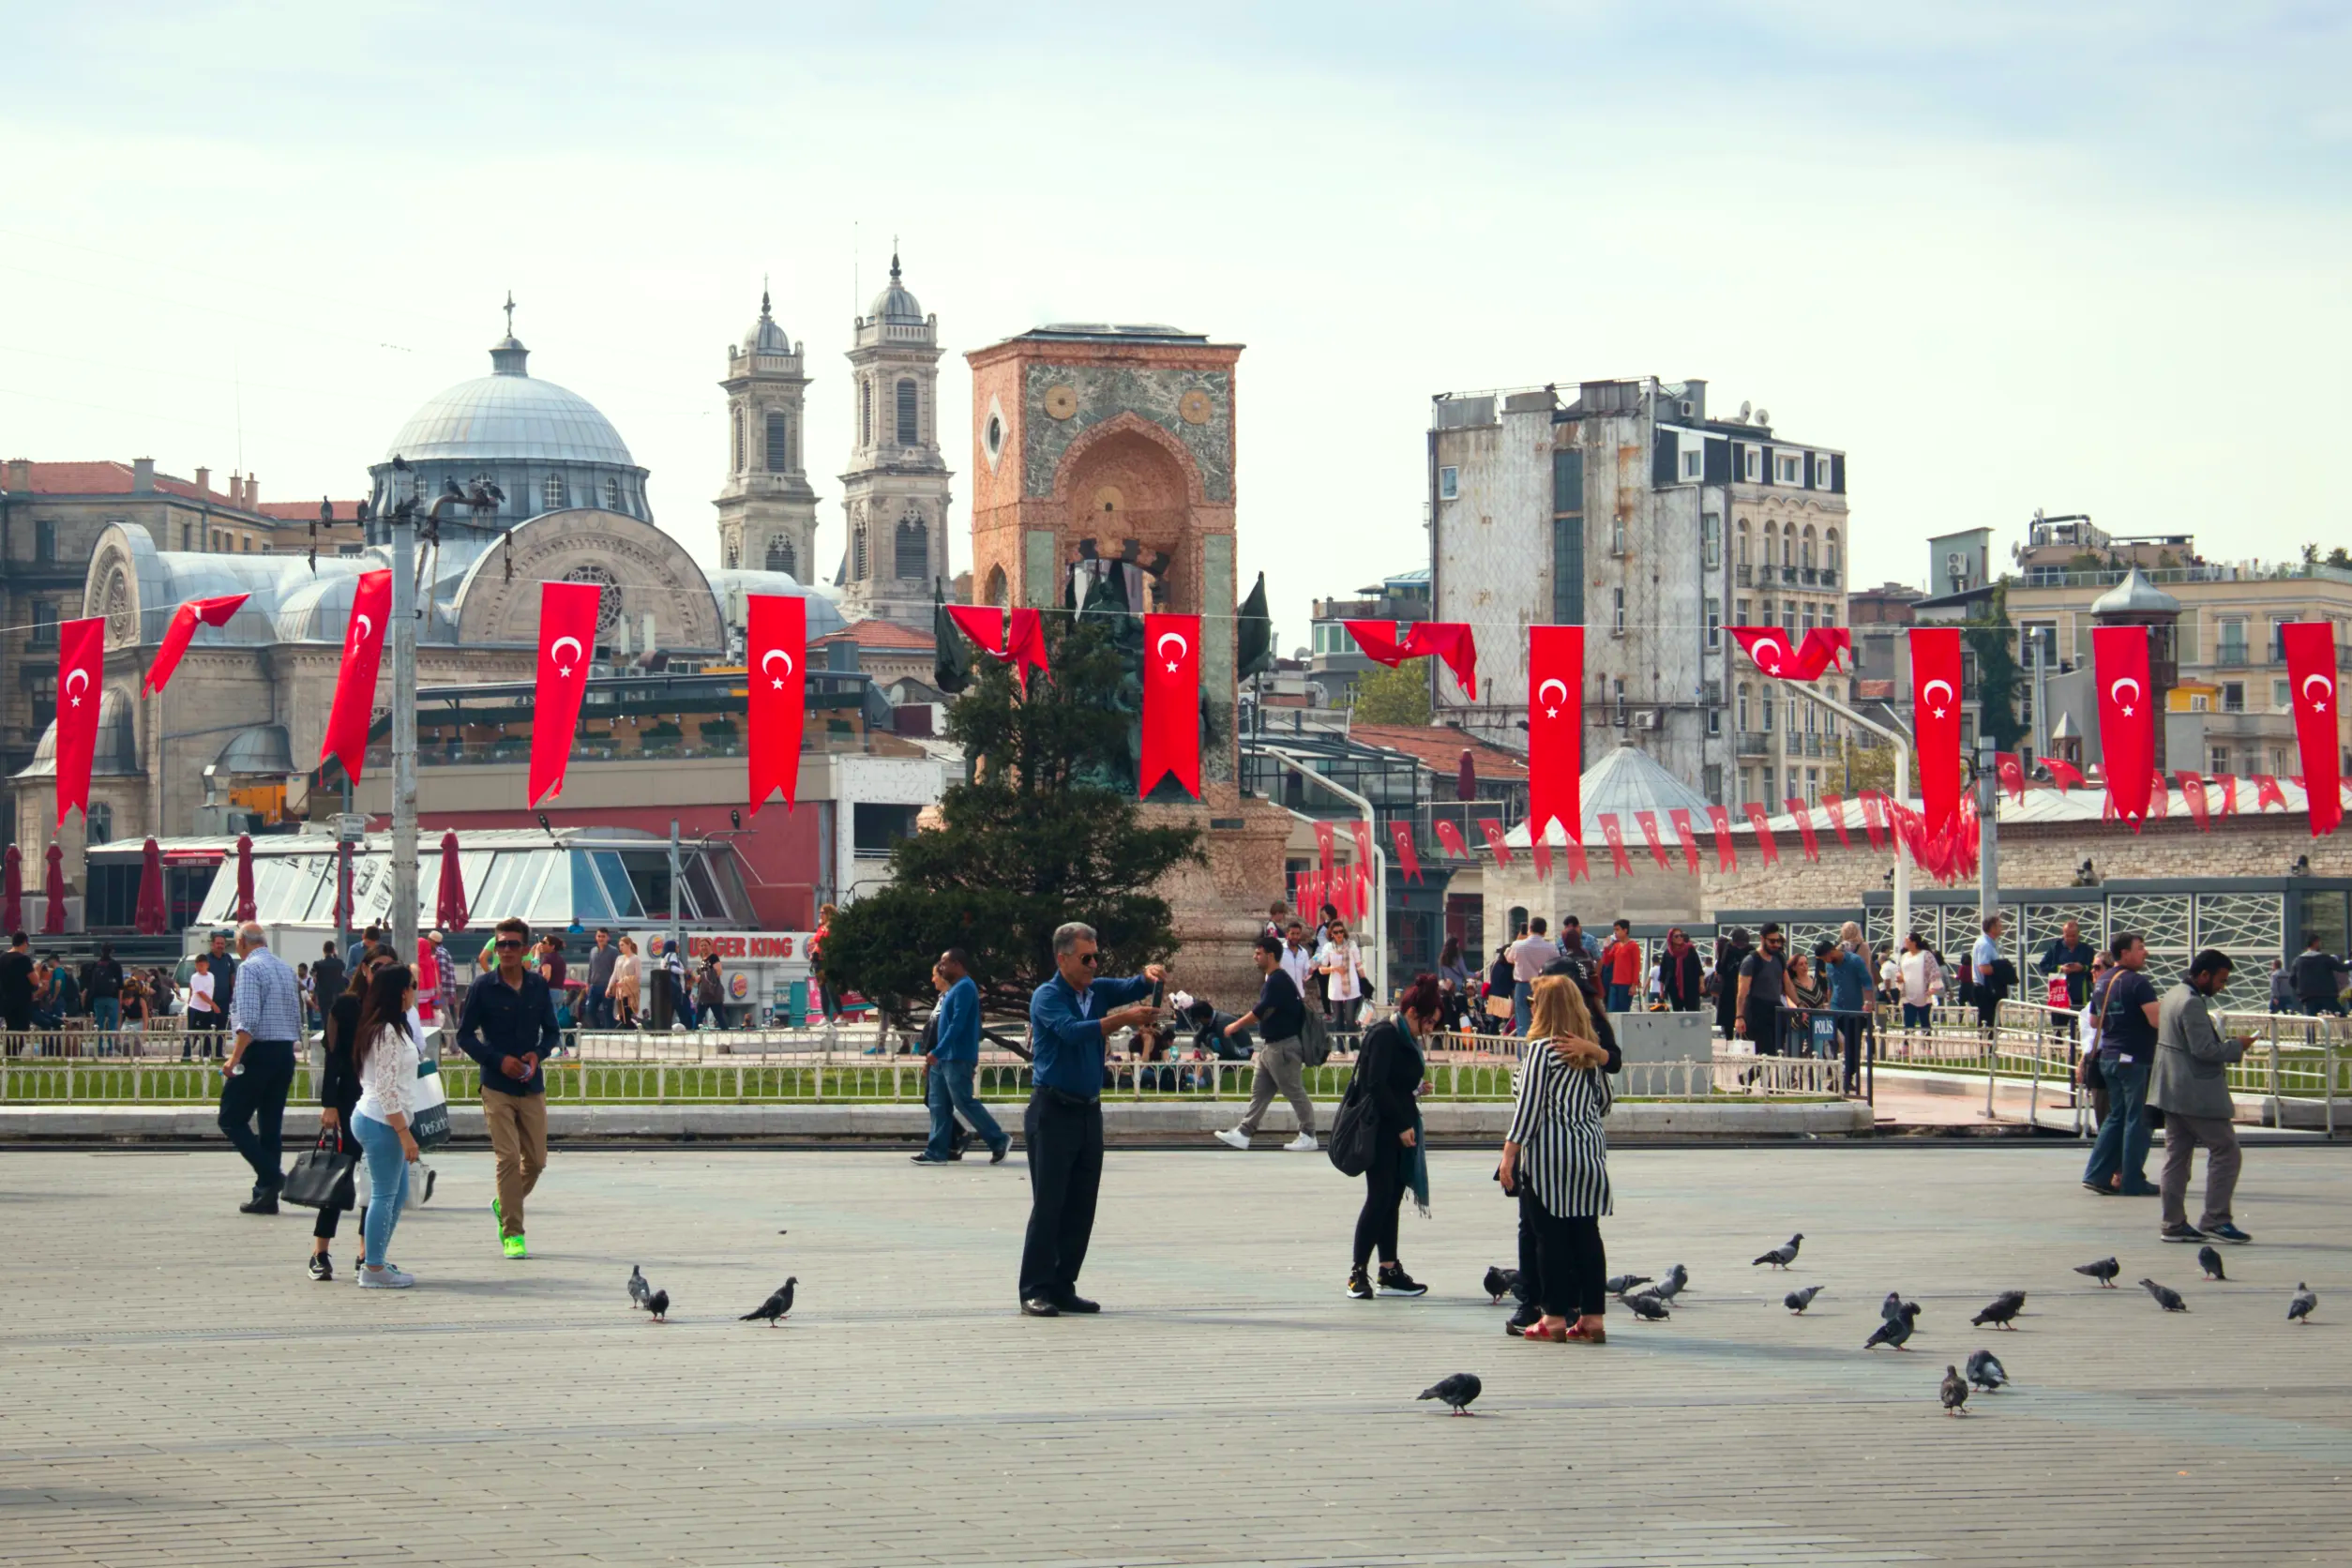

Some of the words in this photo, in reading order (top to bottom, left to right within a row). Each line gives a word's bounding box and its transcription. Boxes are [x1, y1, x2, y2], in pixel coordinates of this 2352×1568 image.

[688, 937, 746, 957] UGER
[750, 937, 793, 958] KING
[2049, 993, 2066, 1002] FREE
[420, 1117, 448, 1137] DeFacto
